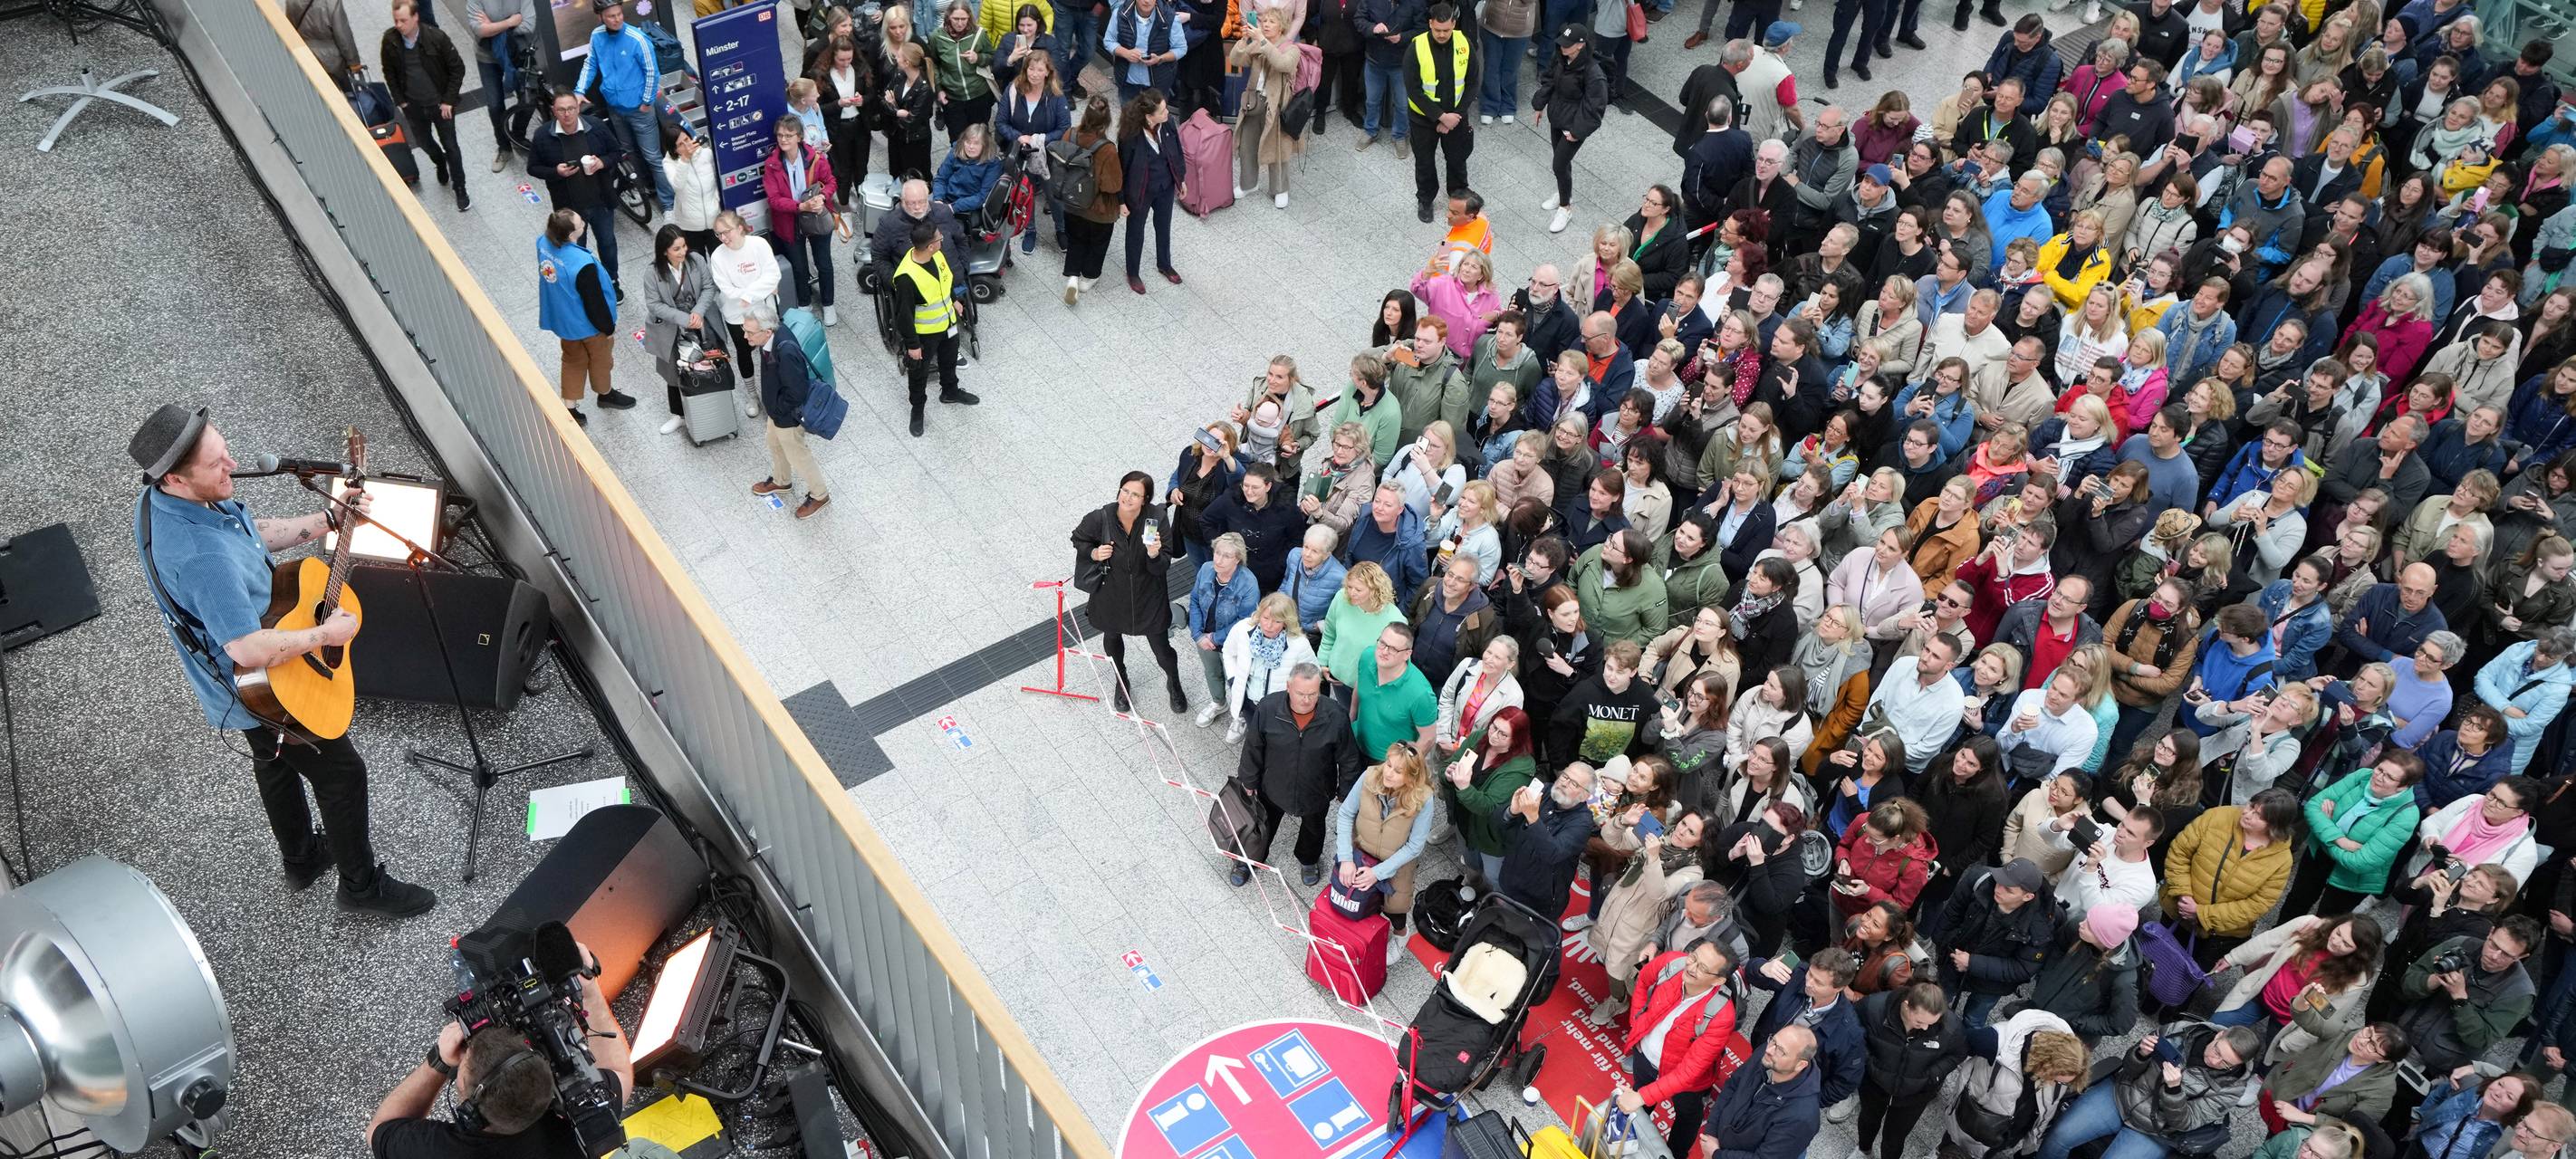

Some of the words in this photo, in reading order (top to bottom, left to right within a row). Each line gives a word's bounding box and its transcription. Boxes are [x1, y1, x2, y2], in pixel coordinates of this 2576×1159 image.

[758, 11, 772, 22] DB
[706, 41, 739, 56] Münster
[726, 94, 750, 111] 2-17
[1588, 704, 1639, 721] MONET
[1572, 1008, 1600, 1033] und
[1560, 1020, 1594, 1051] mehr
[1591, 1052, 1612, 1071] für
